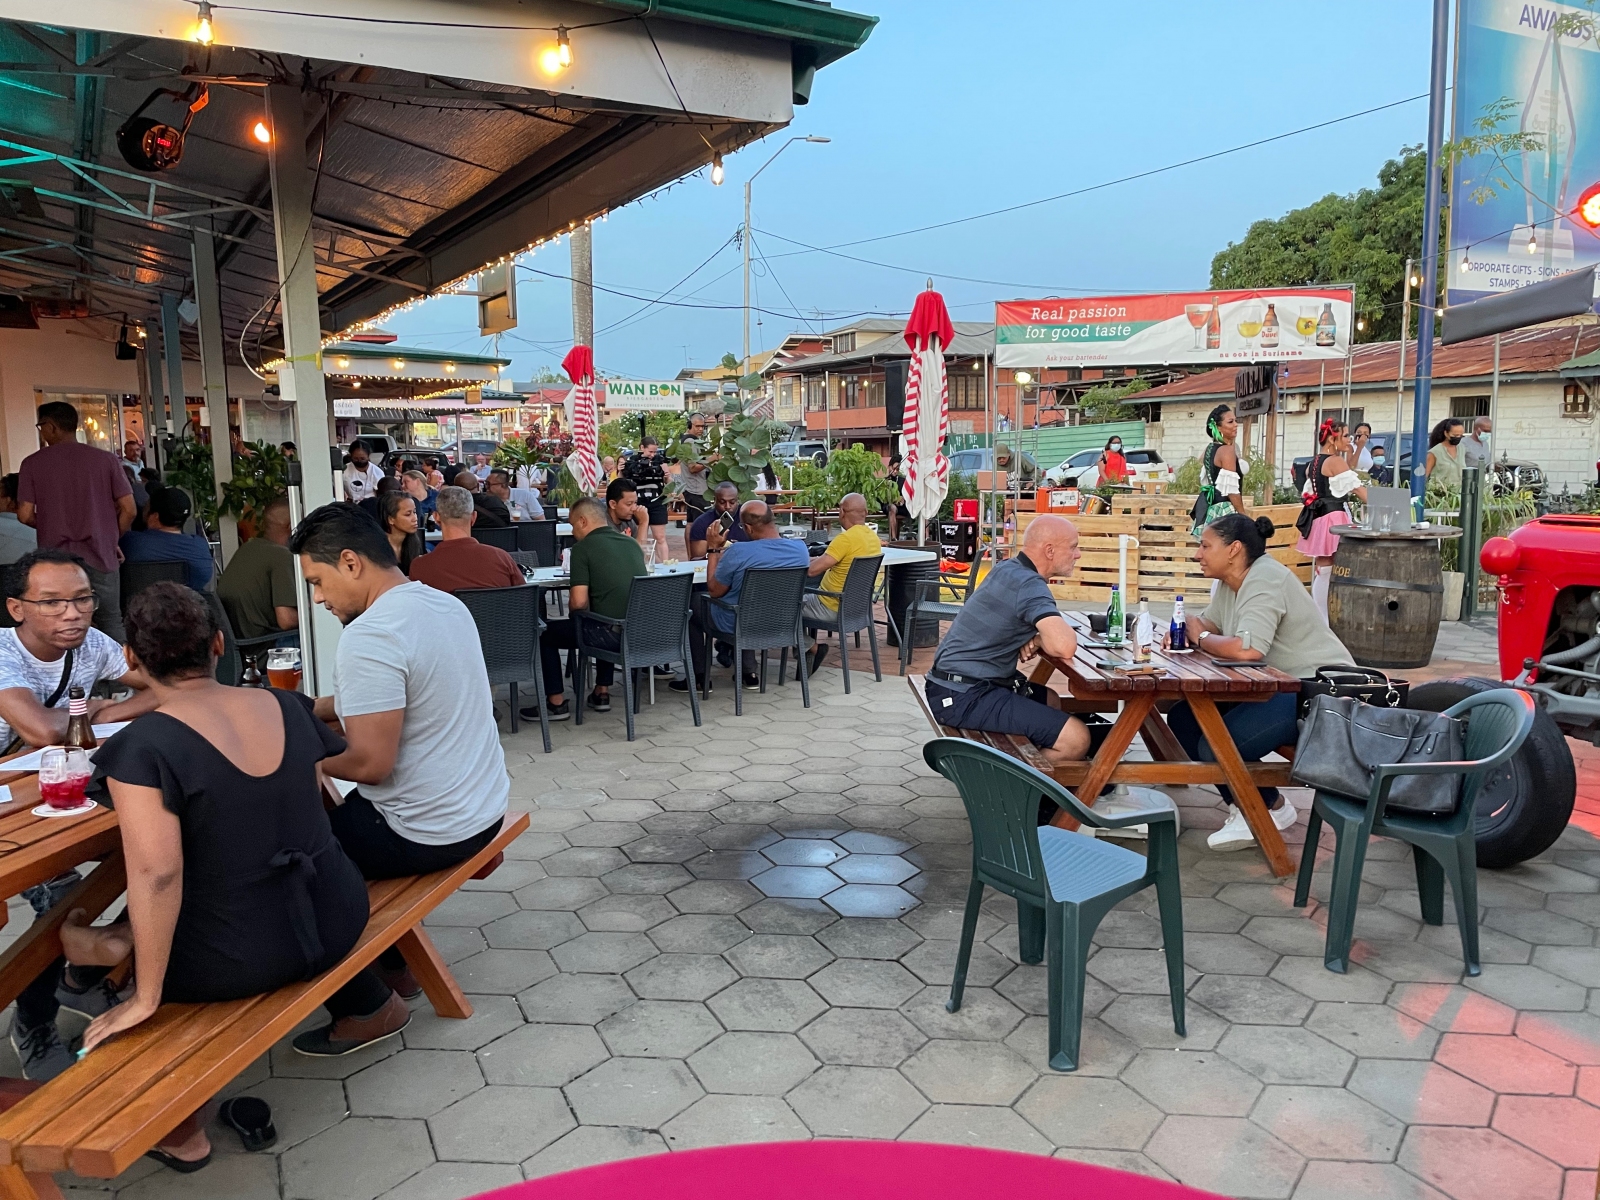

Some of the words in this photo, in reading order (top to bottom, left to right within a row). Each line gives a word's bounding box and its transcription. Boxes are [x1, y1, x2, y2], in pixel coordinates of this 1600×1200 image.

[1519, 4, 1592, 41] AWADS
[1462, 262, 1510, 274] ORPORATE
[1512, 264, 1532, 275] GIFTS
[1538, 266, 1560, 277] SIGNS
[1490, 278, 1520, 289] STAMPS
[1031, 306, 1064, 320] Real
[1067, 304, 1127, 323] passion
[1025, 325, 1047, 339] for
[1051, 325, 1090, 341] good
[1095, 324, 1132, 337] taste
[1059, 354, 1075, 364] your
[1076, 353, 1109, 361] bartender
[1251, 349, 1260, 357] in
[1262, 349, 1303, 357] Suriname
[609, 383, 645, 396] WAN
[649, 384, 681, 396] BON
